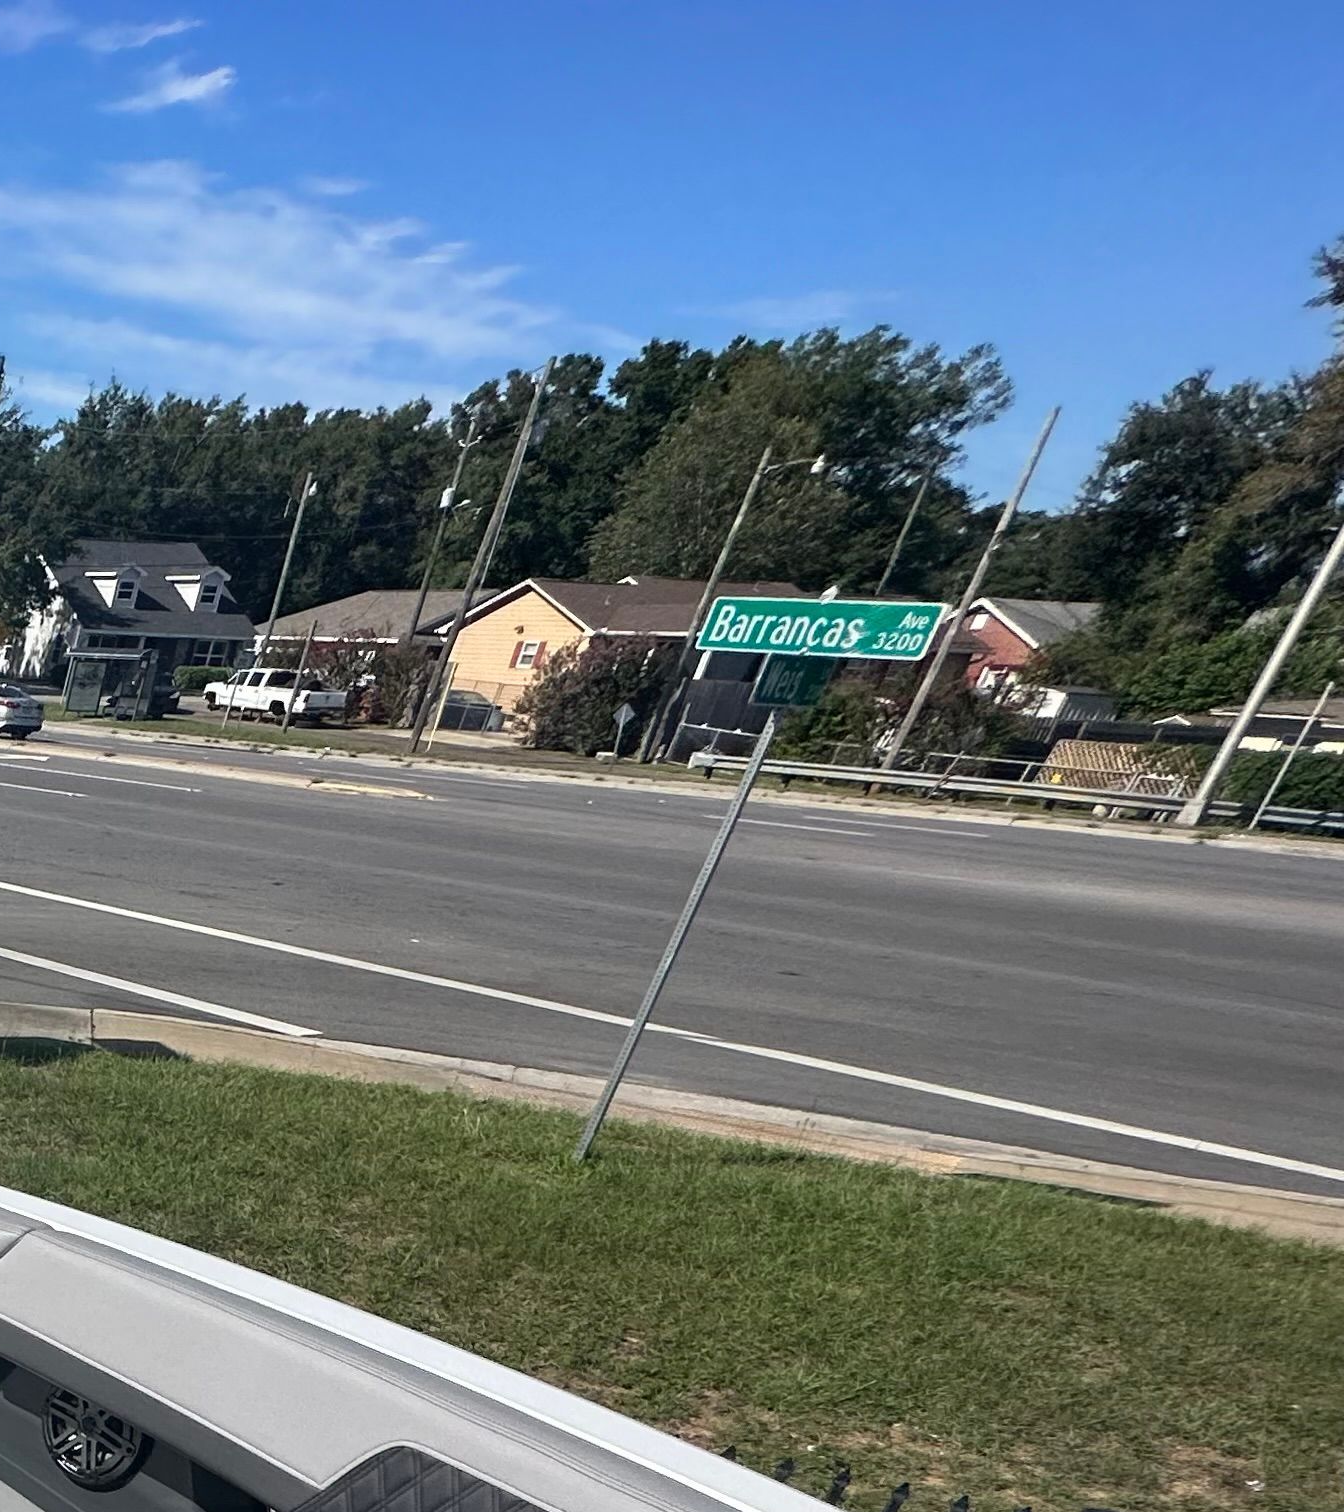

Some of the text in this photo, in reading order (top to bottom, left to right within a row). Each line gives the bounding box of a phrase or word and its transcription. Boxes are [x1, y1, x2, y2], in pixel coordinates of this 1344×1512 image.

[708, 604, 865, 649] Barrancas
[898, 611, 930, 630] Ave
[872, 632, 925, 651] 3200
